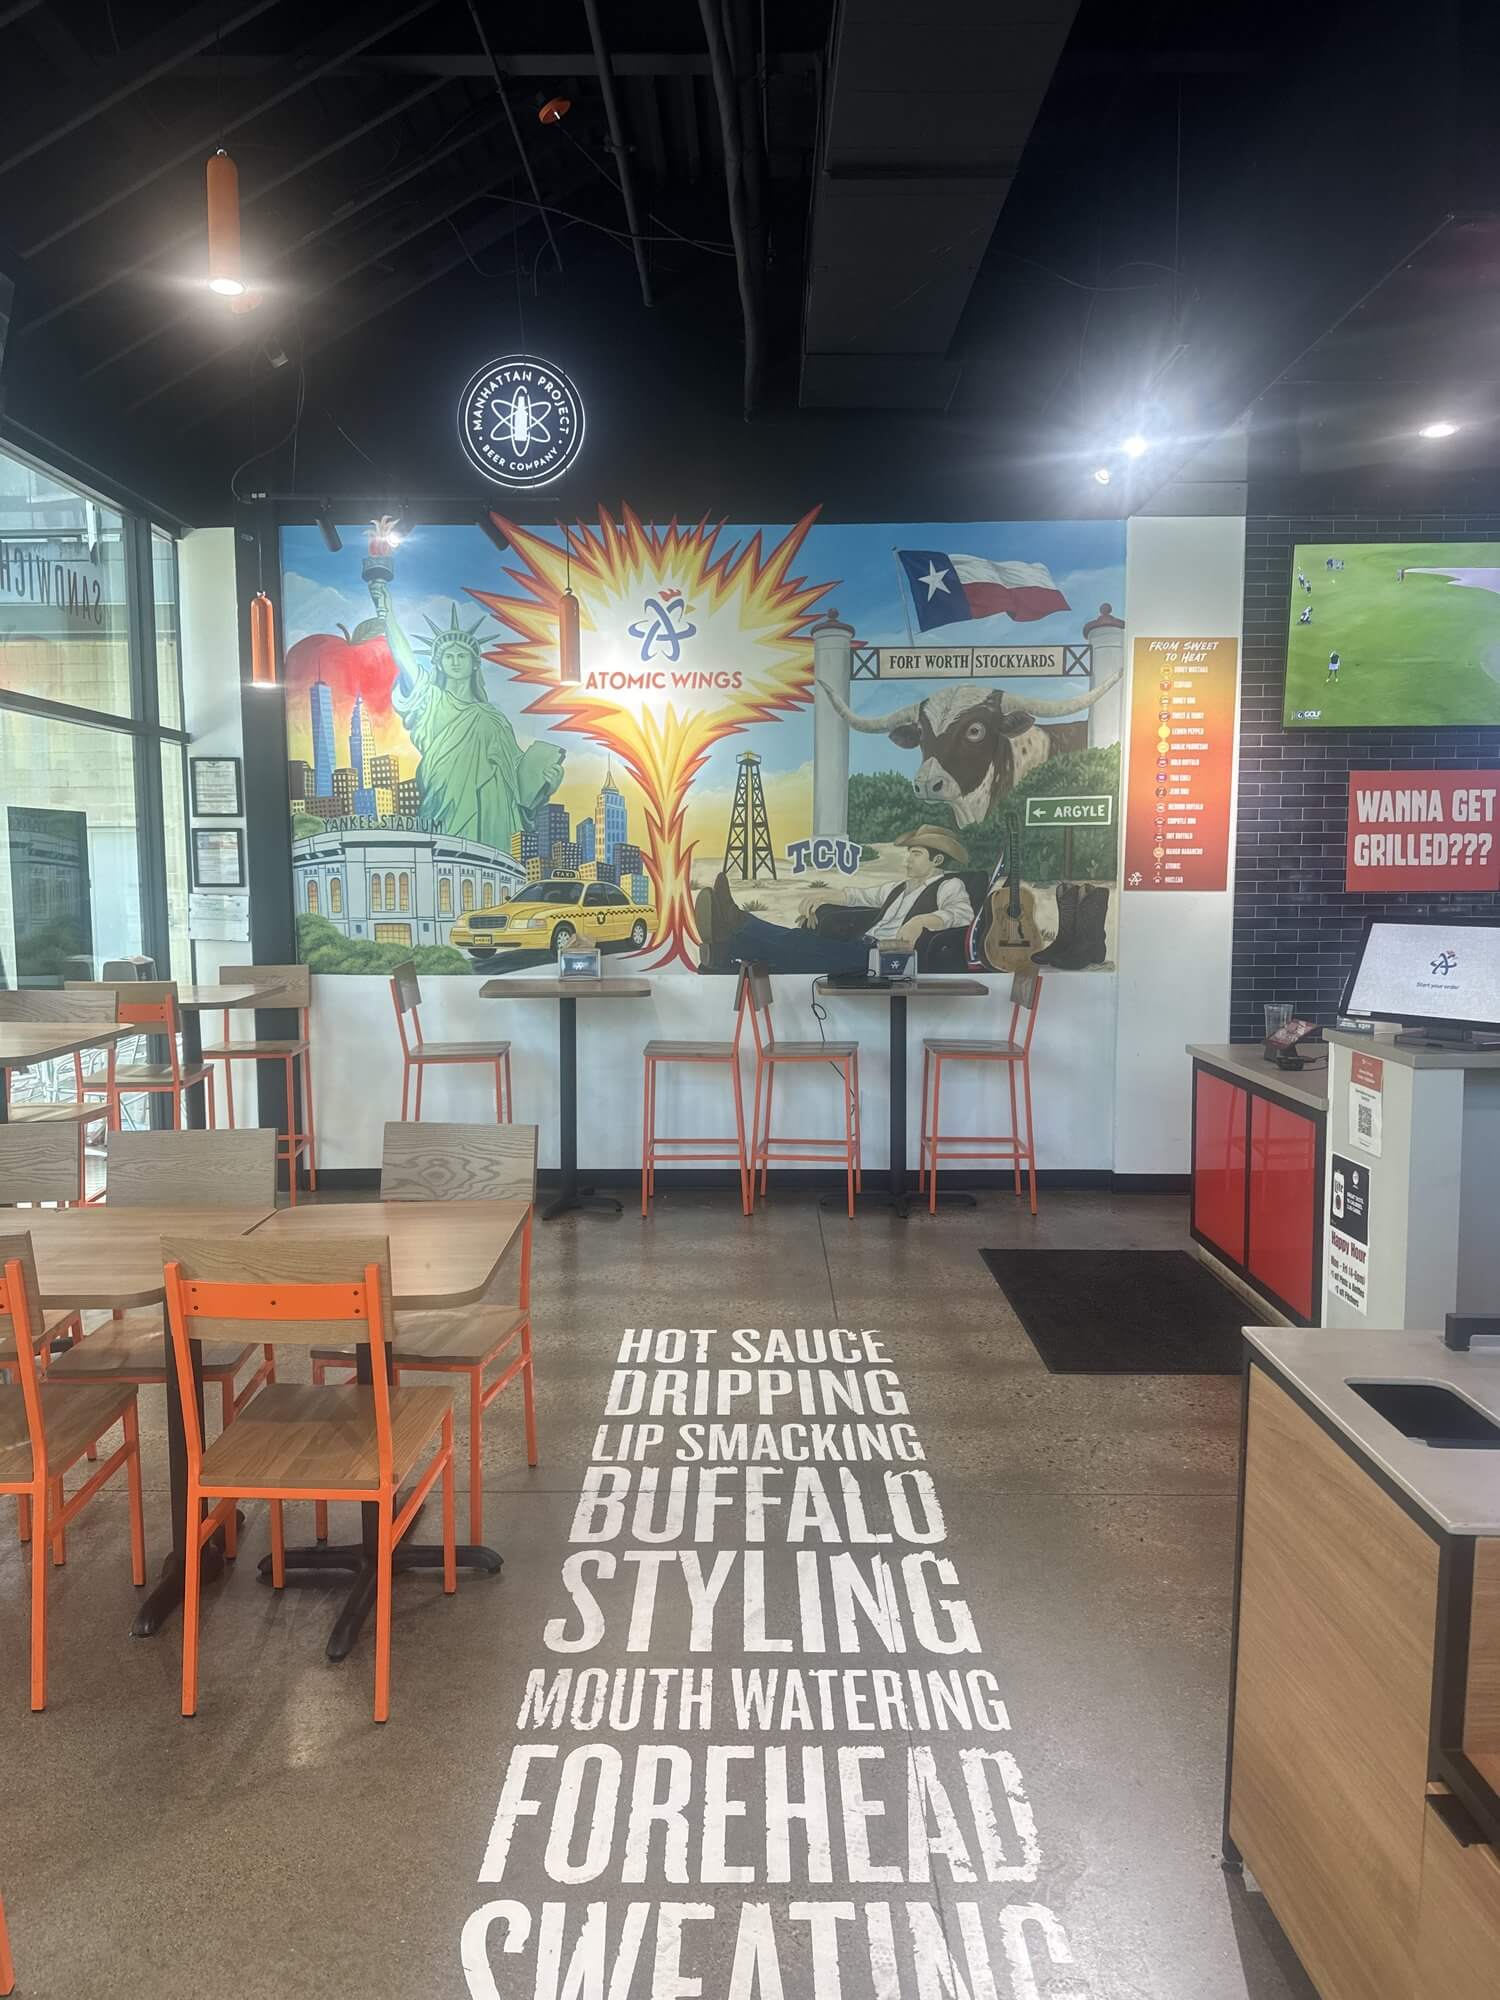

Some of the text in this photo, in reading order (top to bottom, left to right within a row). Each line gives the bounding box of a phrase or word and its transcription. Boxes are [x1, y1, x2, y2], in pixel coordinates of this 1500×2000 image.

[472, 371, 570, 435] MANHATTAN PROJECT
[482, 444, 558, 471] BEER COMPANY
[889, 653, 1055, 669] FORT WORTH STOCKYARDS
[1149, 641, 1219, 652] FROM SWEET
[1165, 652, 1208, 663] TO HEAT
[585, 671, 743, 690] ATOMIC WINGS
[1053, 804, 1105, 818] ARGYLE
[1356, 789, 1497, 823] WANNA GET
[322, 814, 444, 834] YANKEE STADIUM
[785, 837, 863, 876] TCU
[1354, 832, 1493, 867] GRILLED???
[1331, 1231, 1367, 1264] Happy Hour
[617, 1328, 894, 1363] HOT SAUCE
[603, 1369, 910, 1416] DRIPPING
[592, 1423, 926, 1461] LIP SMACKING
[568, 1466, 948, 1544] BUFFALO
[543, 1550, 982, 1654] STYLING
[516, 1668, 1012, 1732] MOUTH WATERING
[477, 1743, 1044, 1884] FOREHEAD
[460, 1900, 1086, 2000] SWEATING
